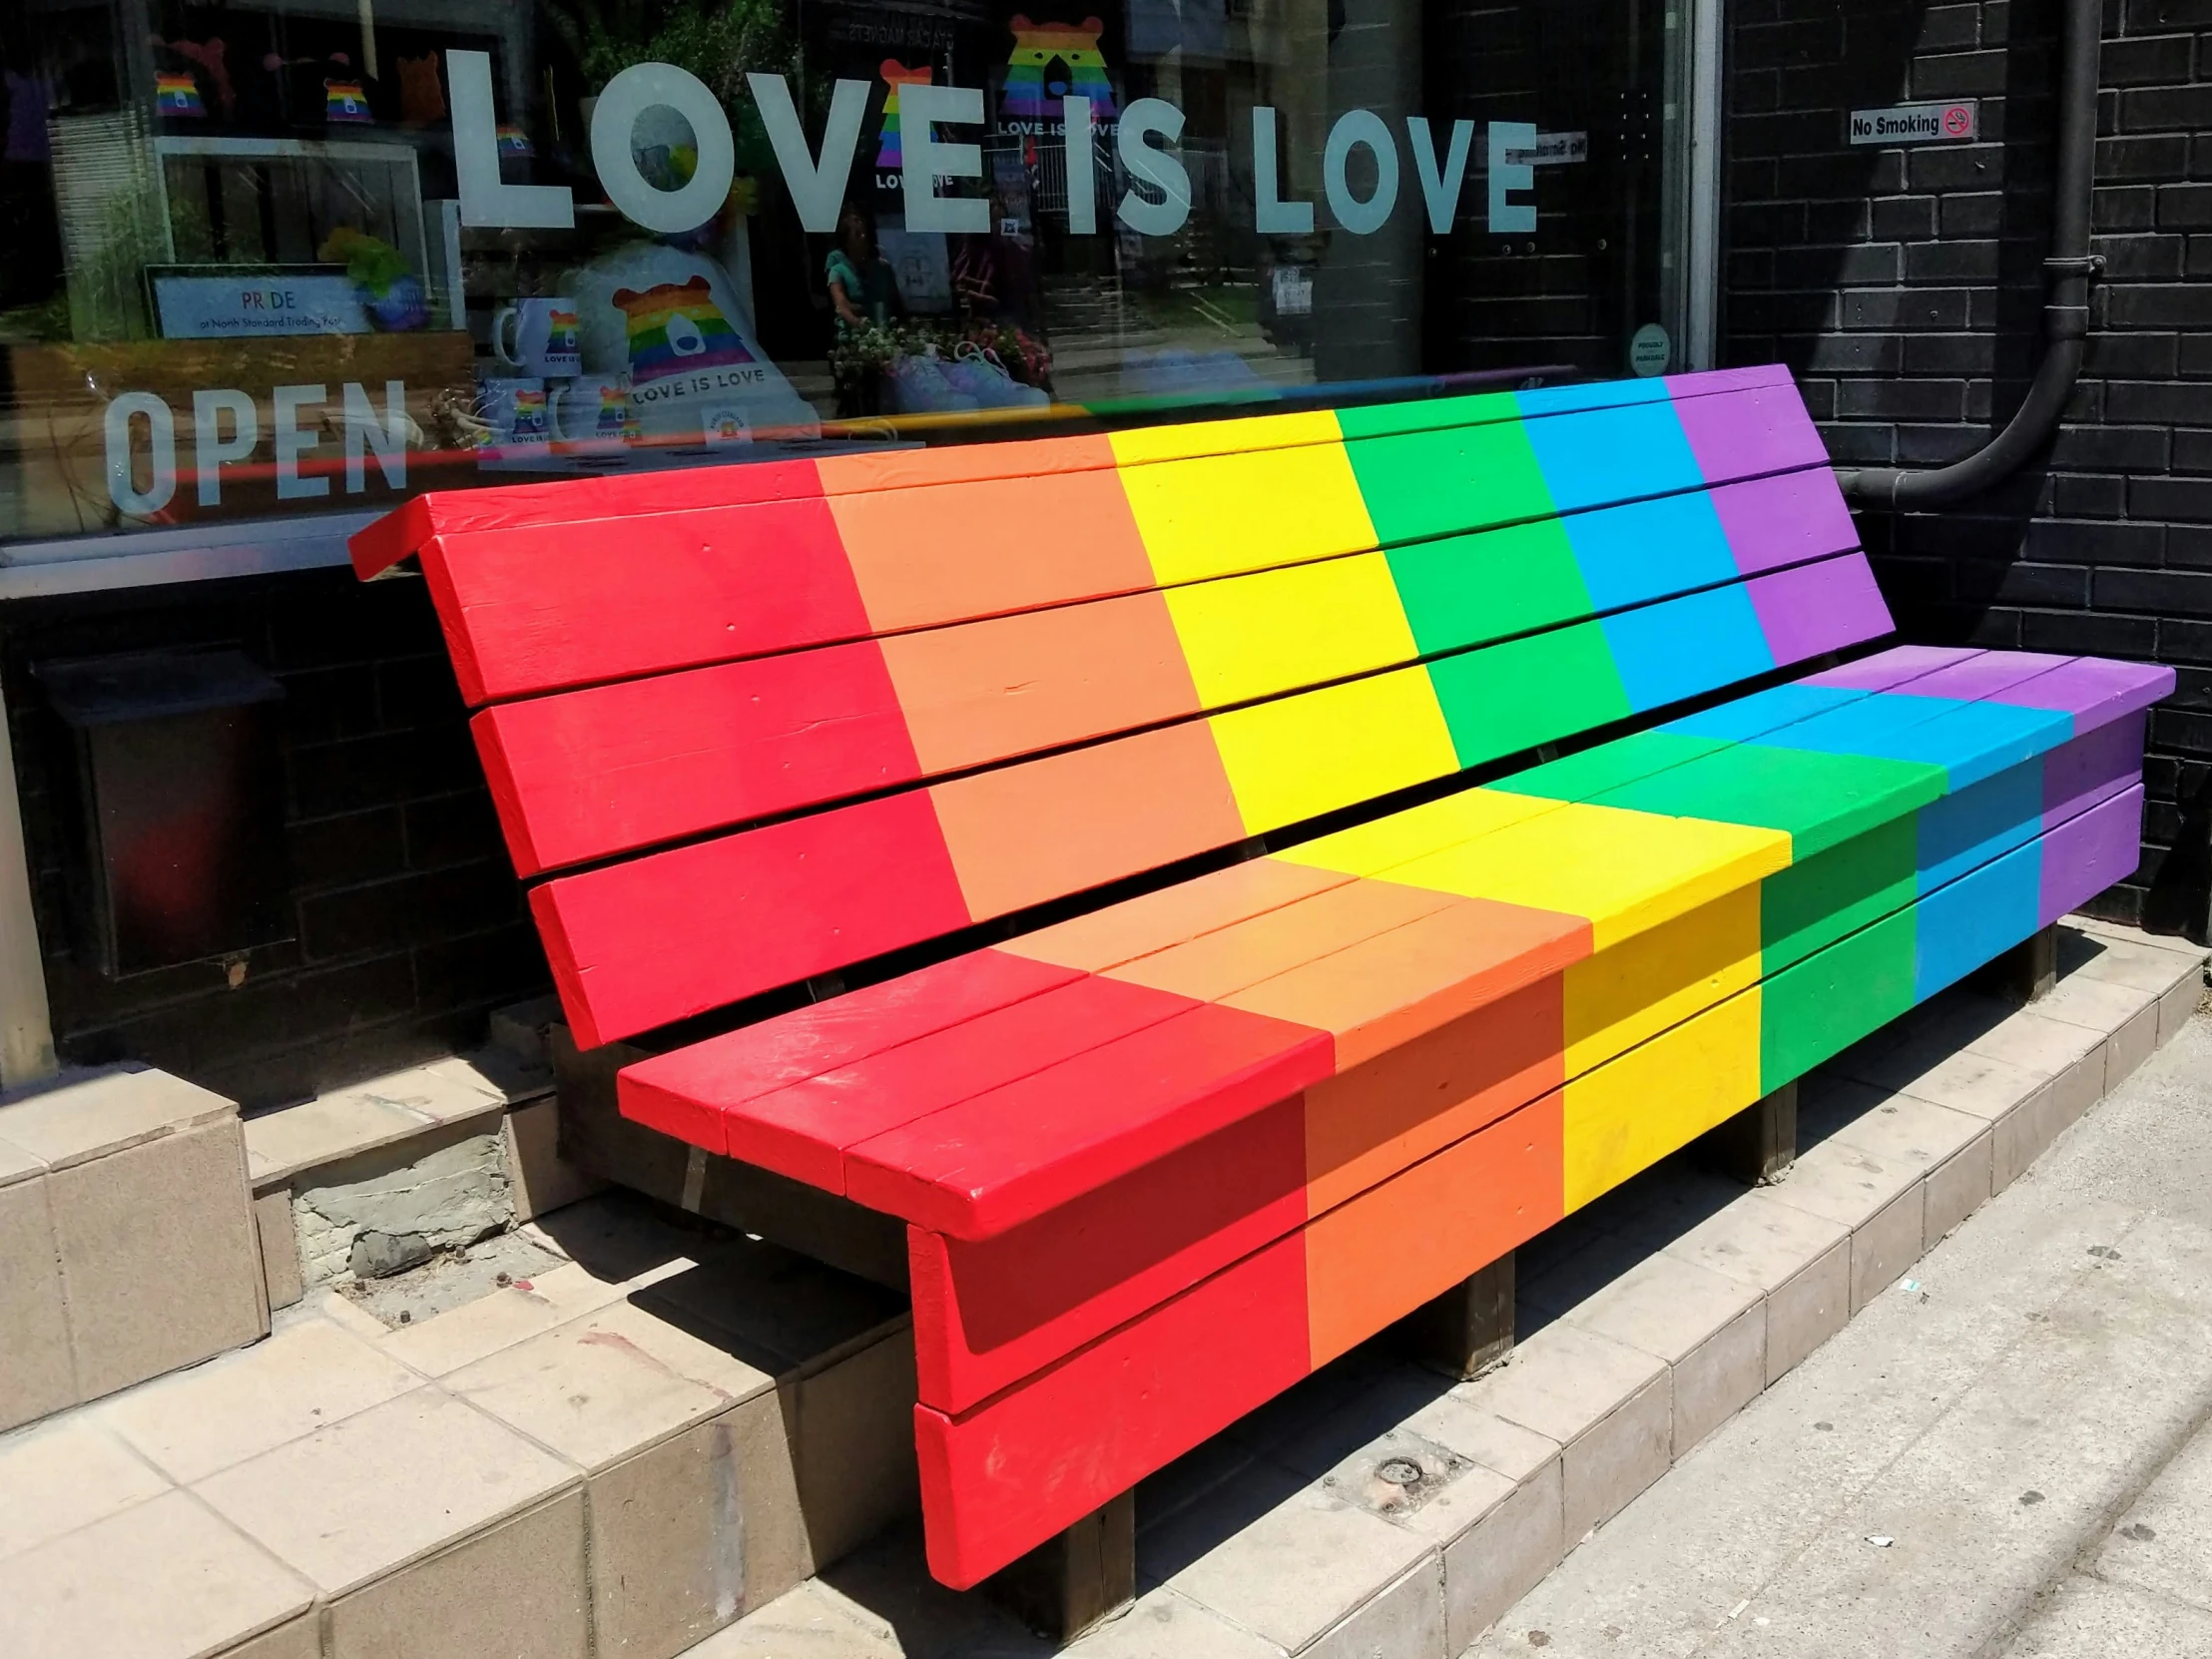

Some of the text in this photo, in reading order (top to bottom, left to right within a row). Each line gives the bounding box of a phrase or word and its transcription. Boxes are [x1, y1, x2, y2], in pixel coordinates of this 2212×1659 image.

[997, 121, 1044, 136] LOVE
[1089, 123, 1119, 137] OVE
[1853, 115, 1939, 136] No Smoking
[446, 49, 1537, 236] LOVE IS LOVE
[243, 315, 284, 327] Standard
[632, 369, 766, 405] LOVE IS LOVE
[105, 380, 407, 515] OPEN
